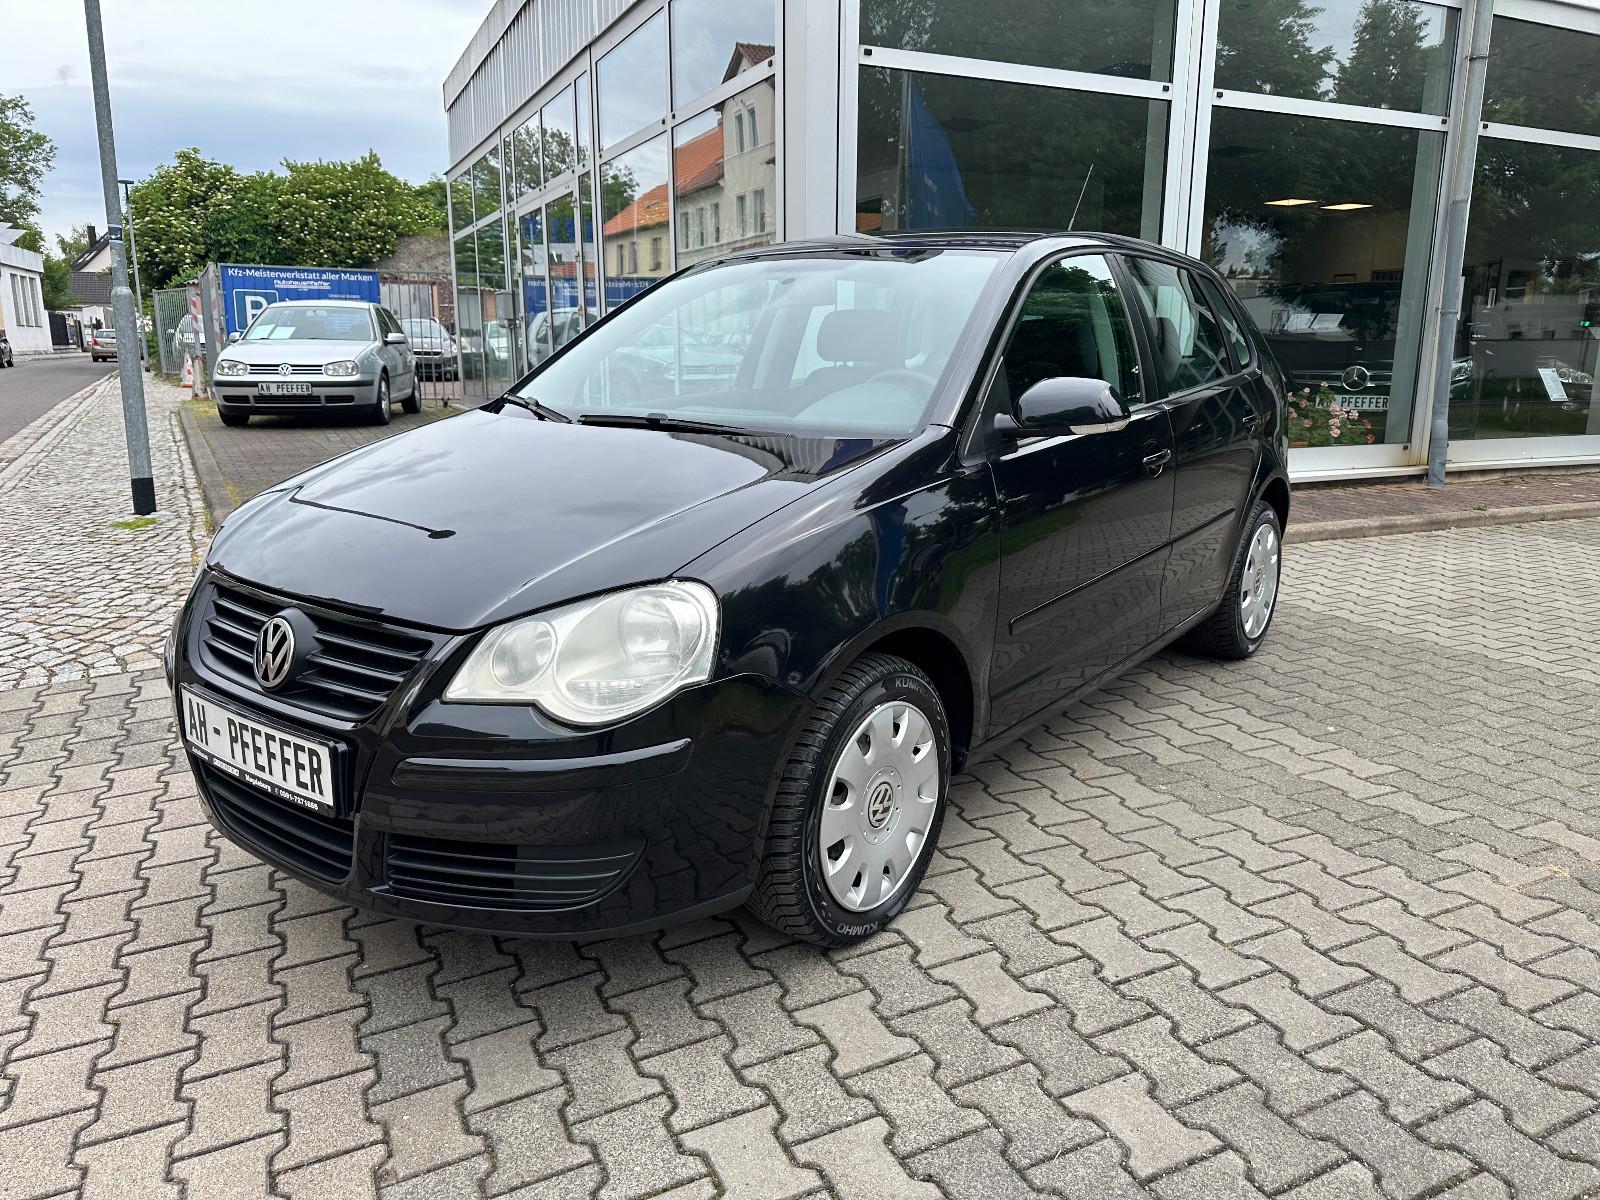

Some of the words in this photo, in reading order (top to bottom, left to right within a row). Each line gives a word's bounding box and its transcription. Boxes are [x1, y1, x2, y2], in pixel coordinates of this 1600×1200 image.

[228, 268, 320, 280] Kfz-Meisterwerkstatt
[321, 271, 340, 280] aller
[341, 273, 373, 282] Marken
[259, 384, 271, 392] AH
[276, 384, 311, 393] PFEFFER
[1340, 396, 1389, 408] PFEFFER
[188, 697, 209, 746] AH
[227, 716, 324, 797] PFEFFER
[836, 921, 879, 936] KUMHO
